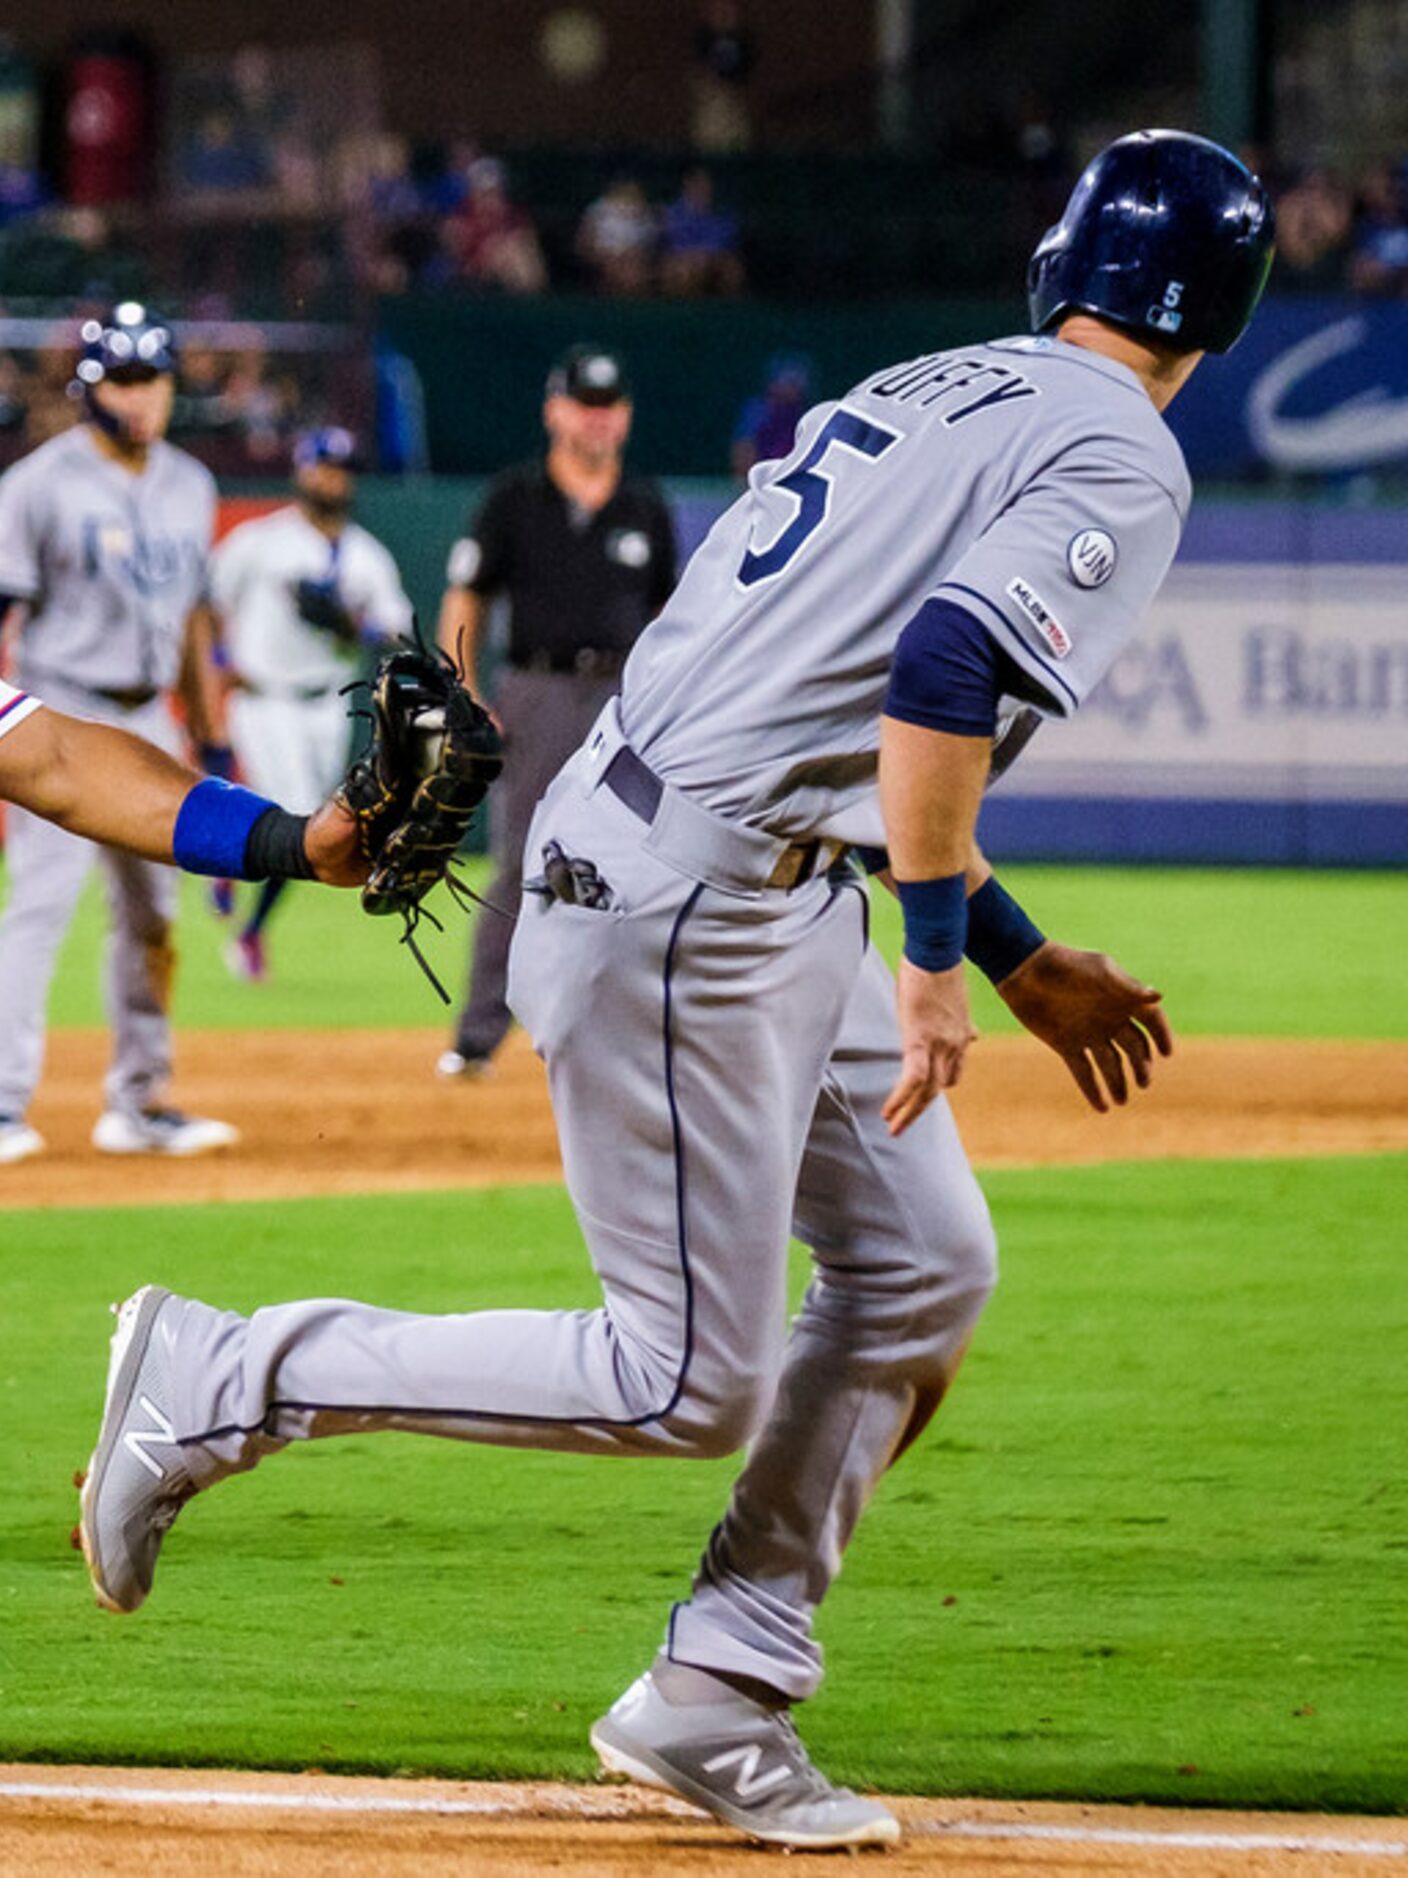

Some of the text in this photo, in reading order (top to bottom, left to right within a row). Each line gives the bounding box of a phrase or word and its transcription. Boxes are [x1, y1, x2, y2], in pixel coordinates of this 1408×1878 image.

[1162, 280, 1185, 308] 5
[866, 354, 1041, 427] UFFY
[735, 402, 907, 593] 5
[1076, 533, 1114, 582] VJN
[1240, 620, 1408, 722] Ban
[702, 1743, 793, 1797] N
